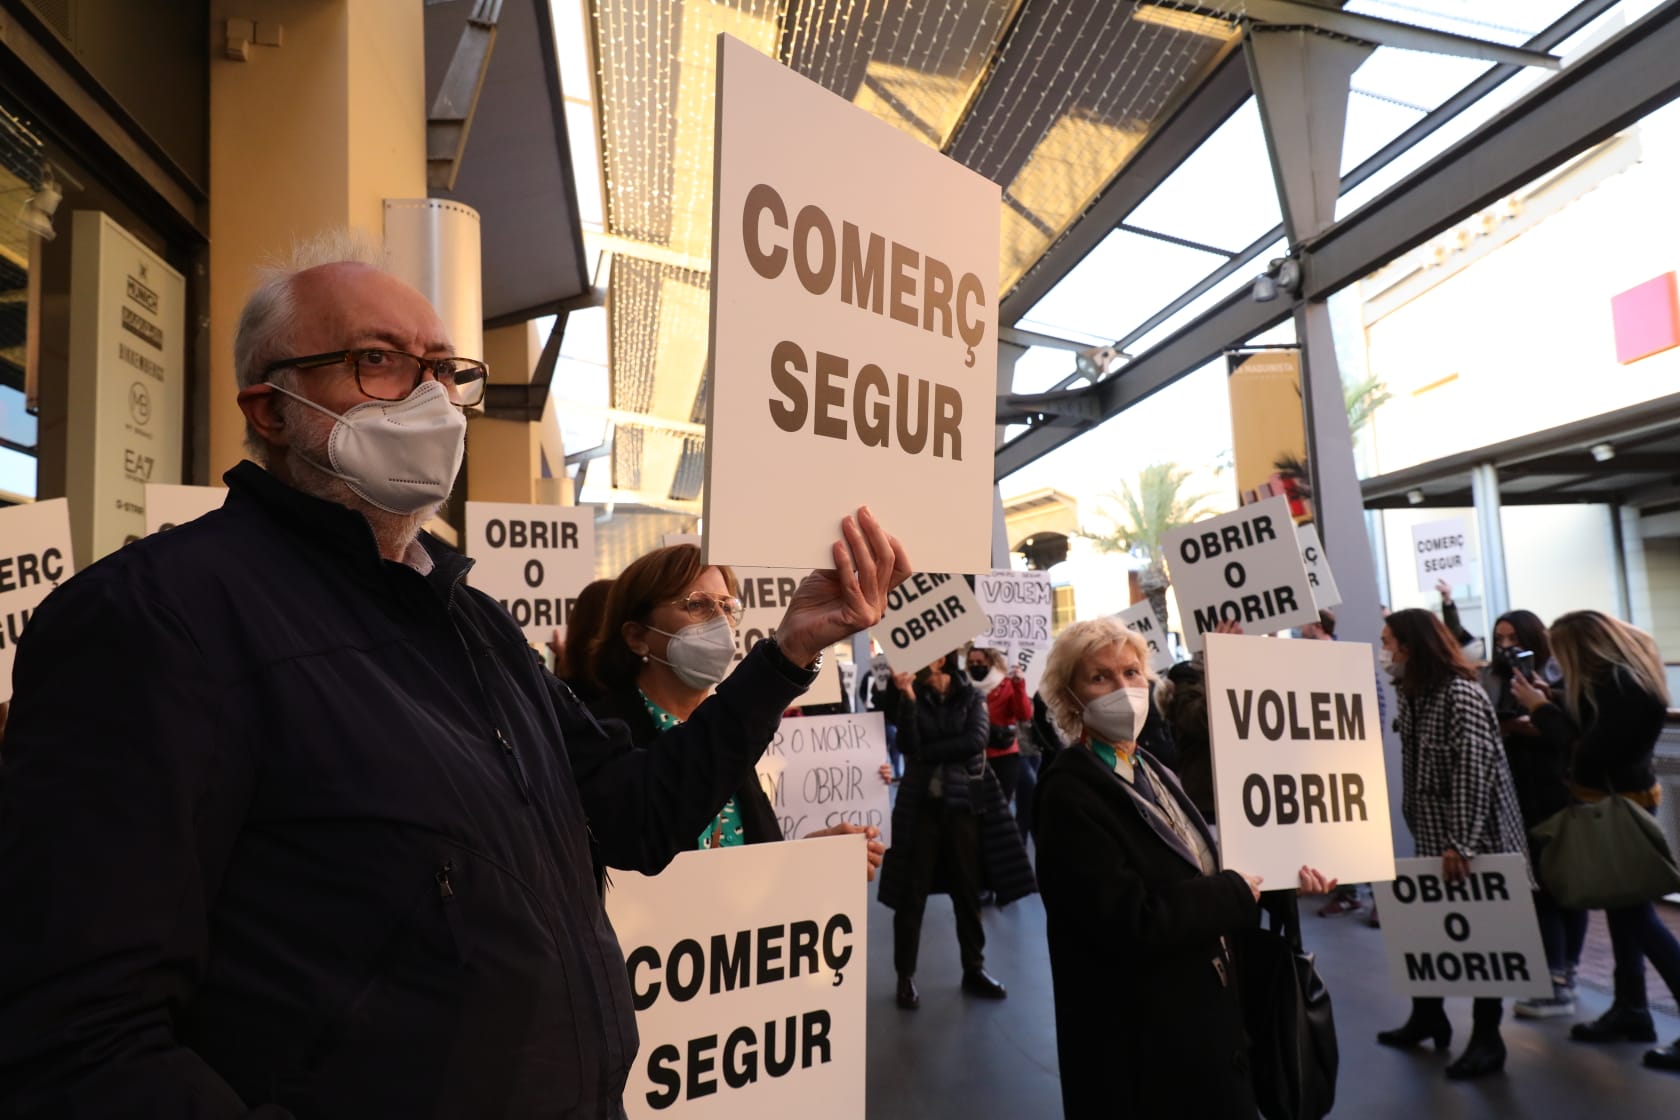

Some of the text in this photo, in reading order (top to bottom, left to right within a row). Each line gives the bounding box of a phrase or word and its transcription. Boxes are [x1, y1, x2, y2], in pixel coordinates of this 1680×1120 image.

[742, 183, 986, 368] COMERÇ
[769, 340, 963, 461] SEGUR
[124, 449, 154, 479] EA7
[485, 519, 579, 549] OBRIR
[1180, 515, 1276, 564] OBRIR
[1417, 534, 1464, 553] COMERÇ
[524, 559, 544, 588] O
[1224, 561, 1246, 589] O
[1424, 555, 1462, 572] SEGUR
[982, 580, 1051, 605] VOLEM
[891, 595, 966, 649] OBRIR
[1194, 585, 1299, 635] MORIR
[1226, 689, 1366, 741] VOLEM
[791, 729, 804, 753] O
[1242, 773, 1368, 827] OBRIR
[1392, 871, 1510, 904] OBRIR
[1444, 912, 1470, 942] O
[625, 913, 853, 1011] COMERÇ
[1405, 952, 1531, 982] MORIR
[646, 1009, 832, 1110] SEGUR
